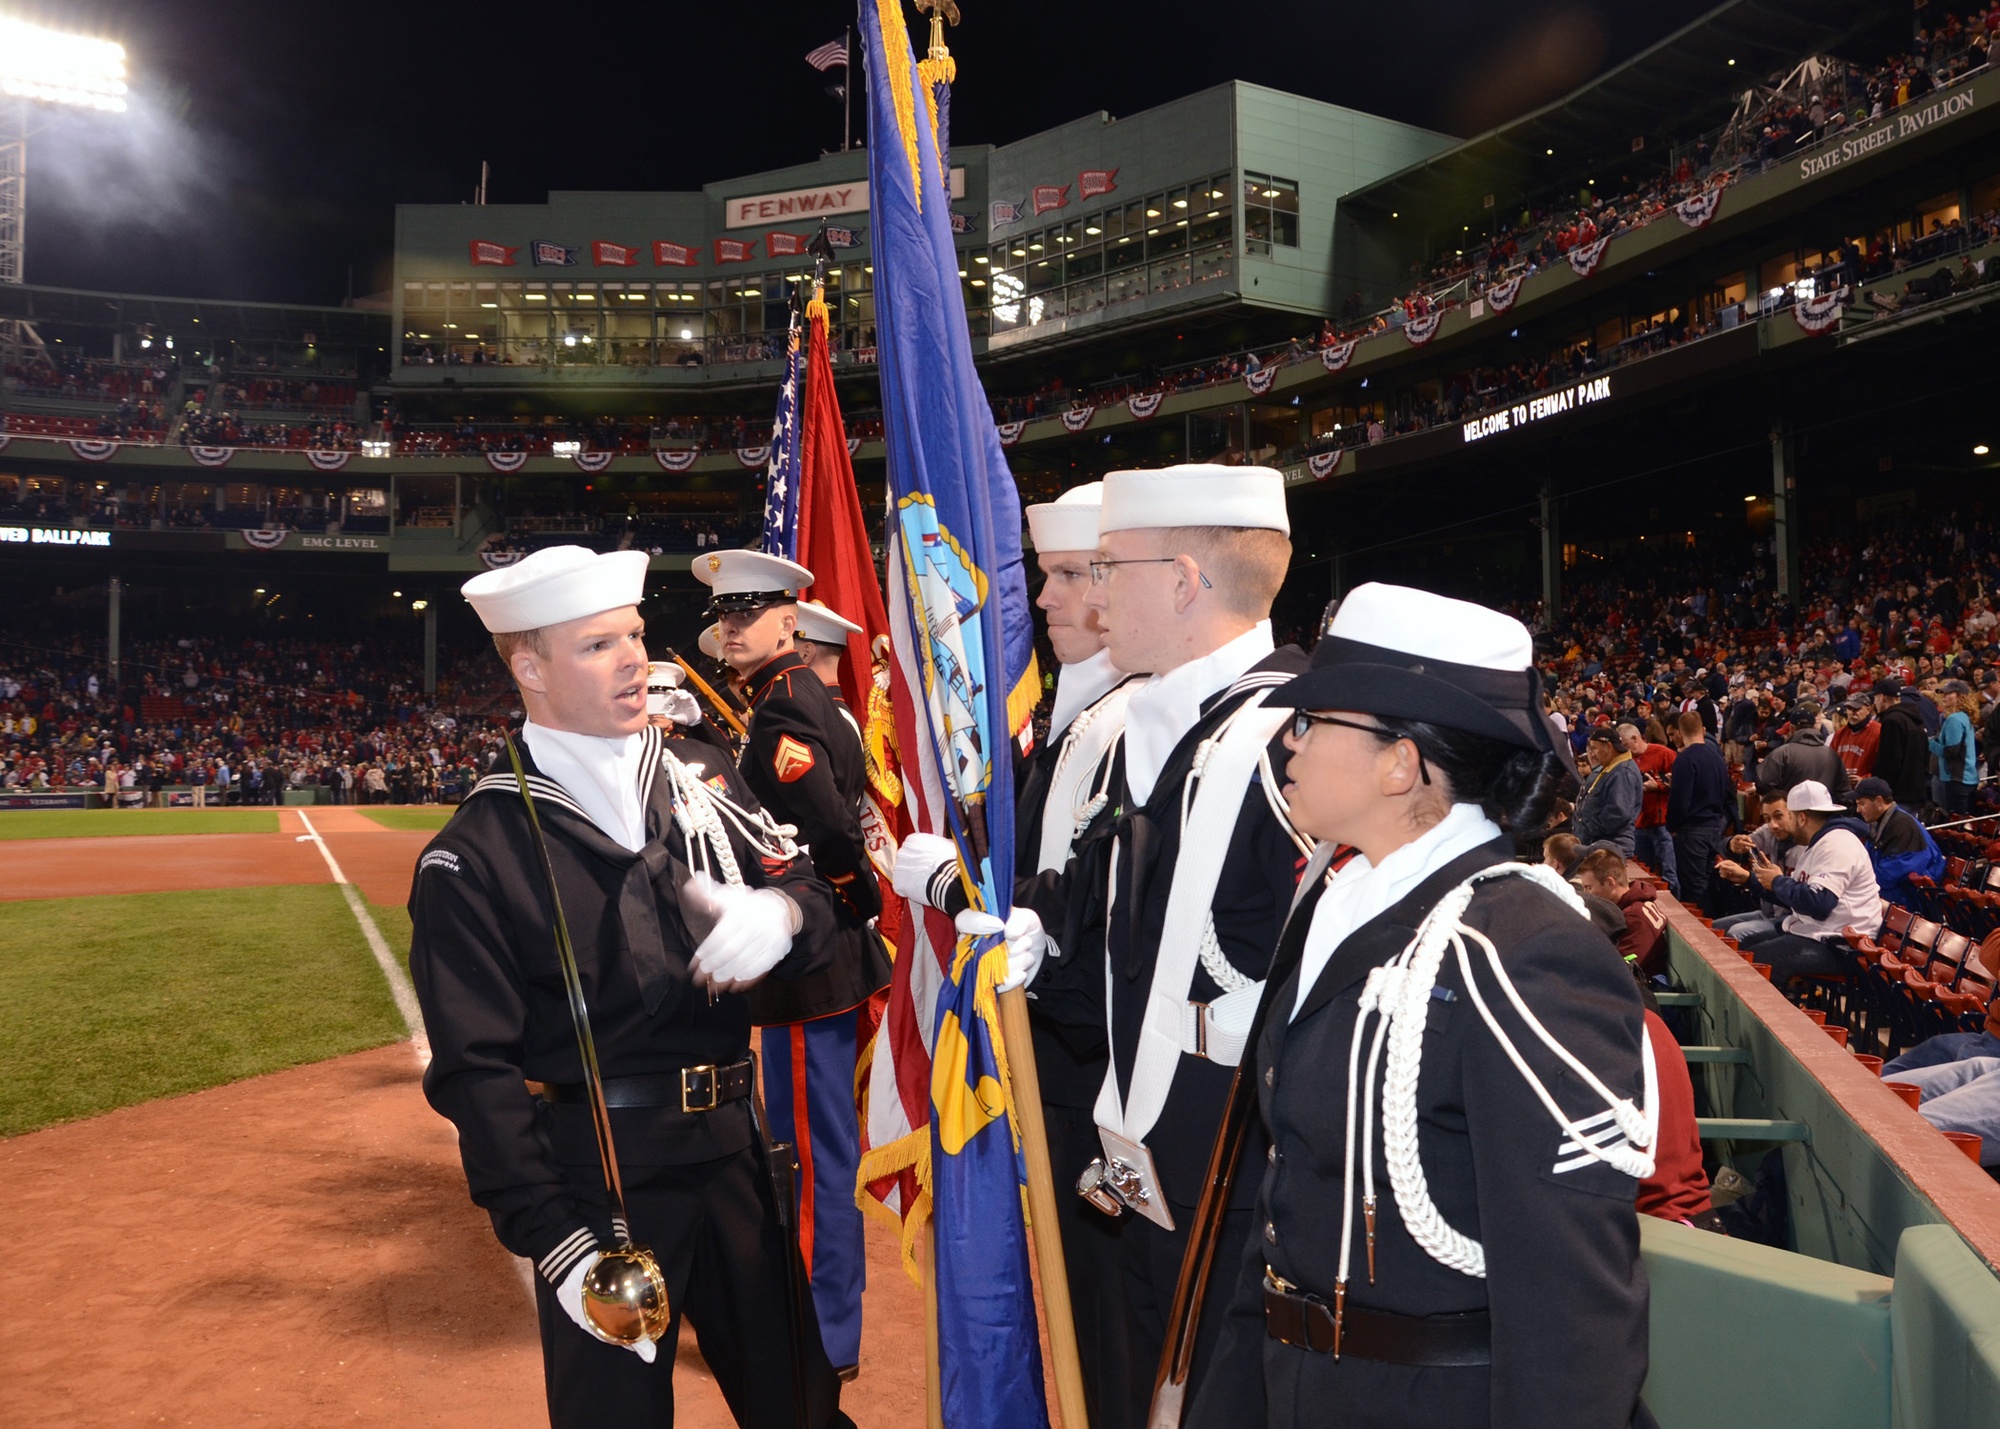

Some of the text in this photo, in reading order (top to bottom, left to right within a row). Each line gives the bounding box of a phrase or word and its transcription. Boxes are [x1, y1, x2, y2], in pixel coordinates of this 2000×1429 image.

[1801, 152, 1841, 180] STATE
[1898, 89, 1974, 138] PAVILION
[741, 189, 852, 220] FENWAY
[1463, 376, 1611, 442] WELCOME TO FENWAY PARK
[31, 528, 111, 546] BALLPARK
[302, 537, 378, 549] EMC LEVEL
